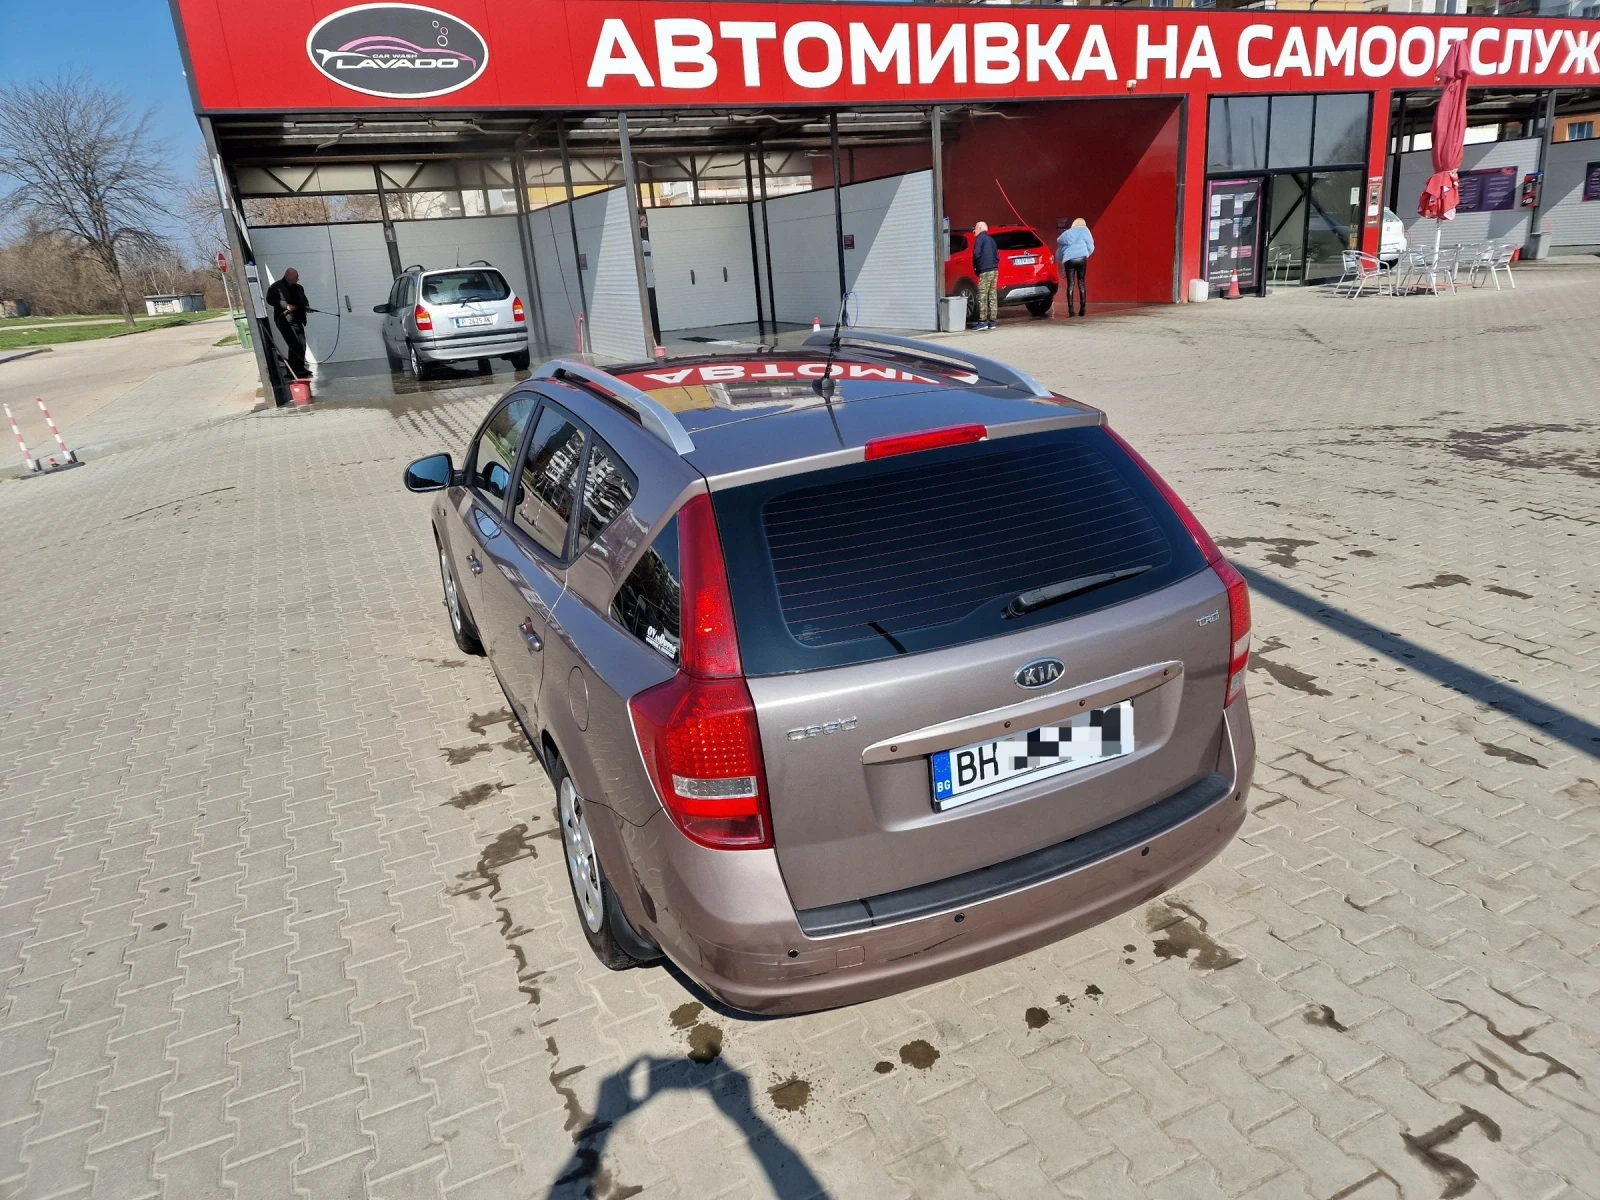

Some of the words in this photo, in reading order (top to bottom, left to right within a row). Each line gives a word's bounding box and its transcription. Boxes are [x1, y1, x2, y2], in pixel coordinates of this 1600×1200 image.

[586, 18, 1118, 89] АВТОМИВКА
[1135, 24, 1222, 80] НА
[336, 59, 459, 69] LAVADO
[640, 215, 648, 227] 2
[1023, 663, 1059, 686] KIA
[937, 779, 950, 793] BG
